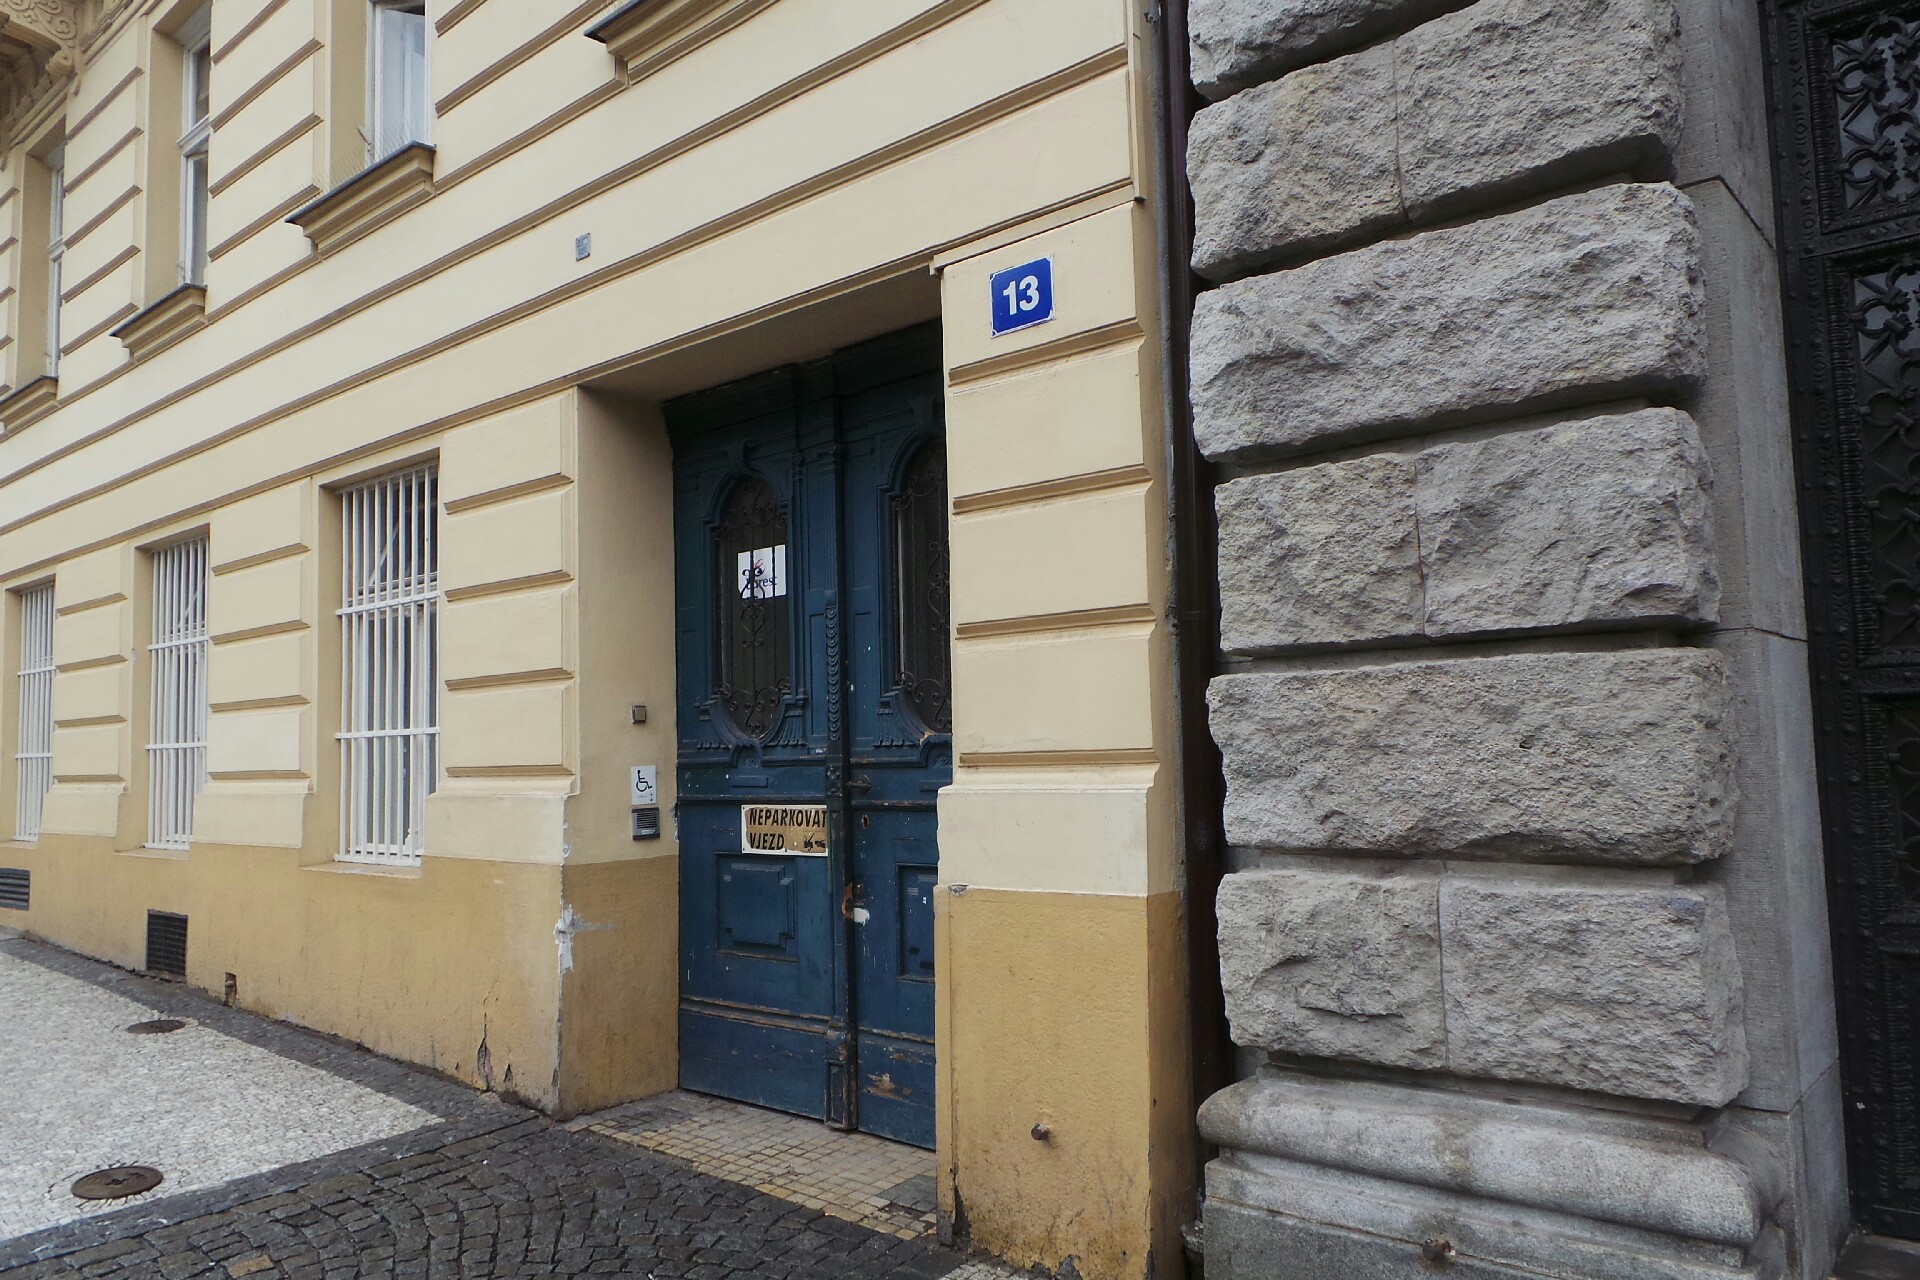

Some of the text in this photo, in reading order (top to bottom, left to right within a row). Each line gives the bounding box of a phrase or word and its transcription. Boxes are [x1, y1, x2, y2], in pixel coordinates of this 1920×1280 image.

[1003, 275, 1040, 315] 13
[749, 809, 827, 827] NEPARKOVAT
[750, 833, 784, 850] VJEZD
